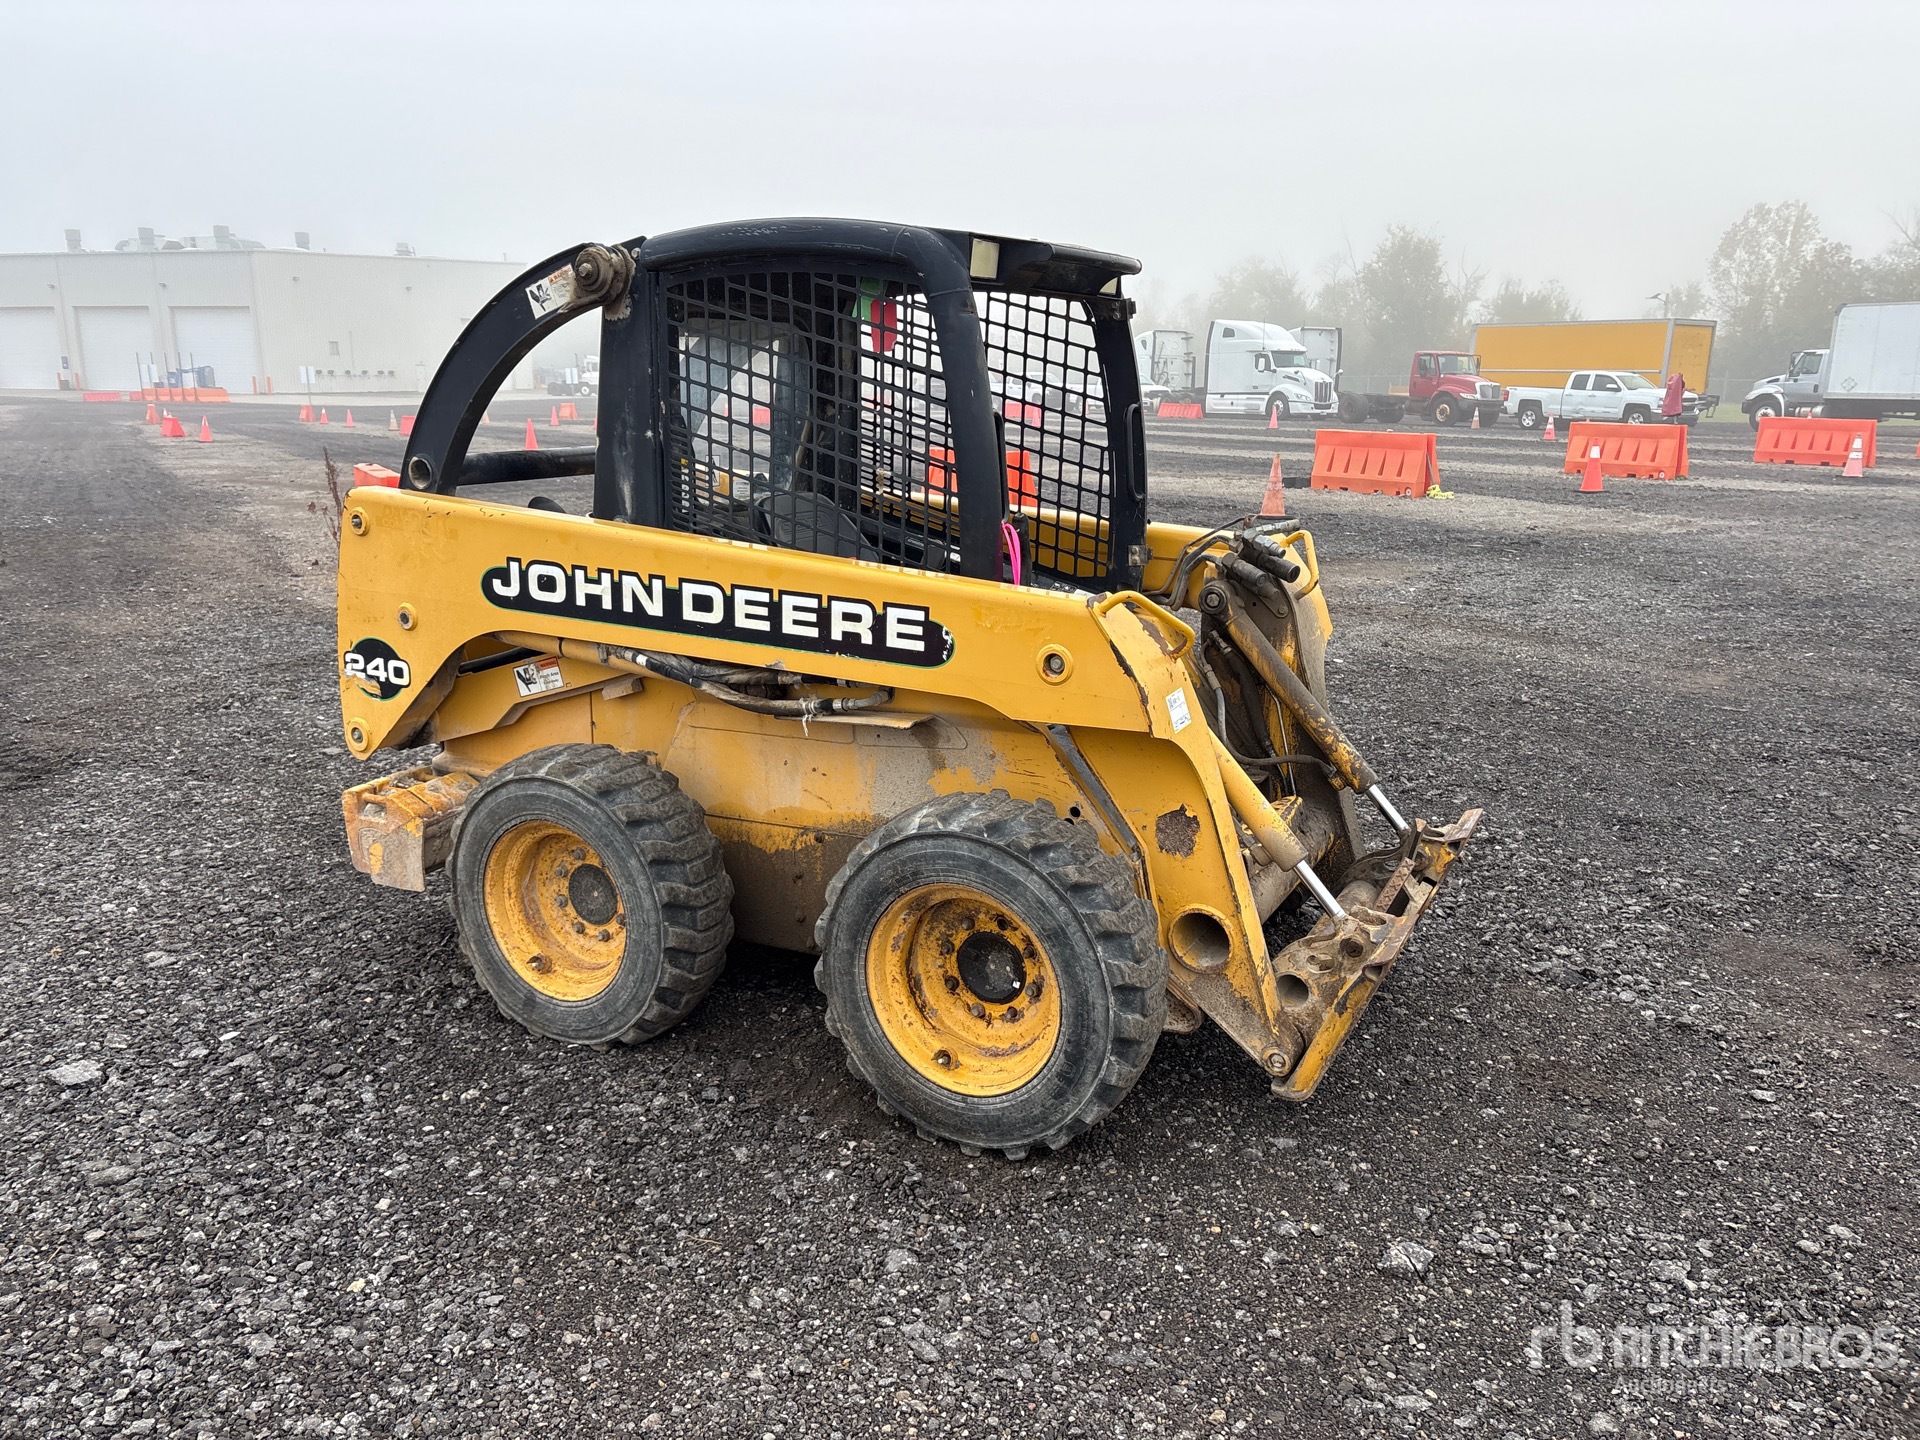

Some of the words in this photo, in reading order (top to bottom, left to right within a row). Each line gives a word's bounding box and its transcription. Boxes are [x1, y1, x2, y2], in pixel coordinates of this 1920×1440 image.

[492, 559, 664, 617] JOHN
[682, 581, 926, 652] DEERE
[344, 652, 410, 686] 240
